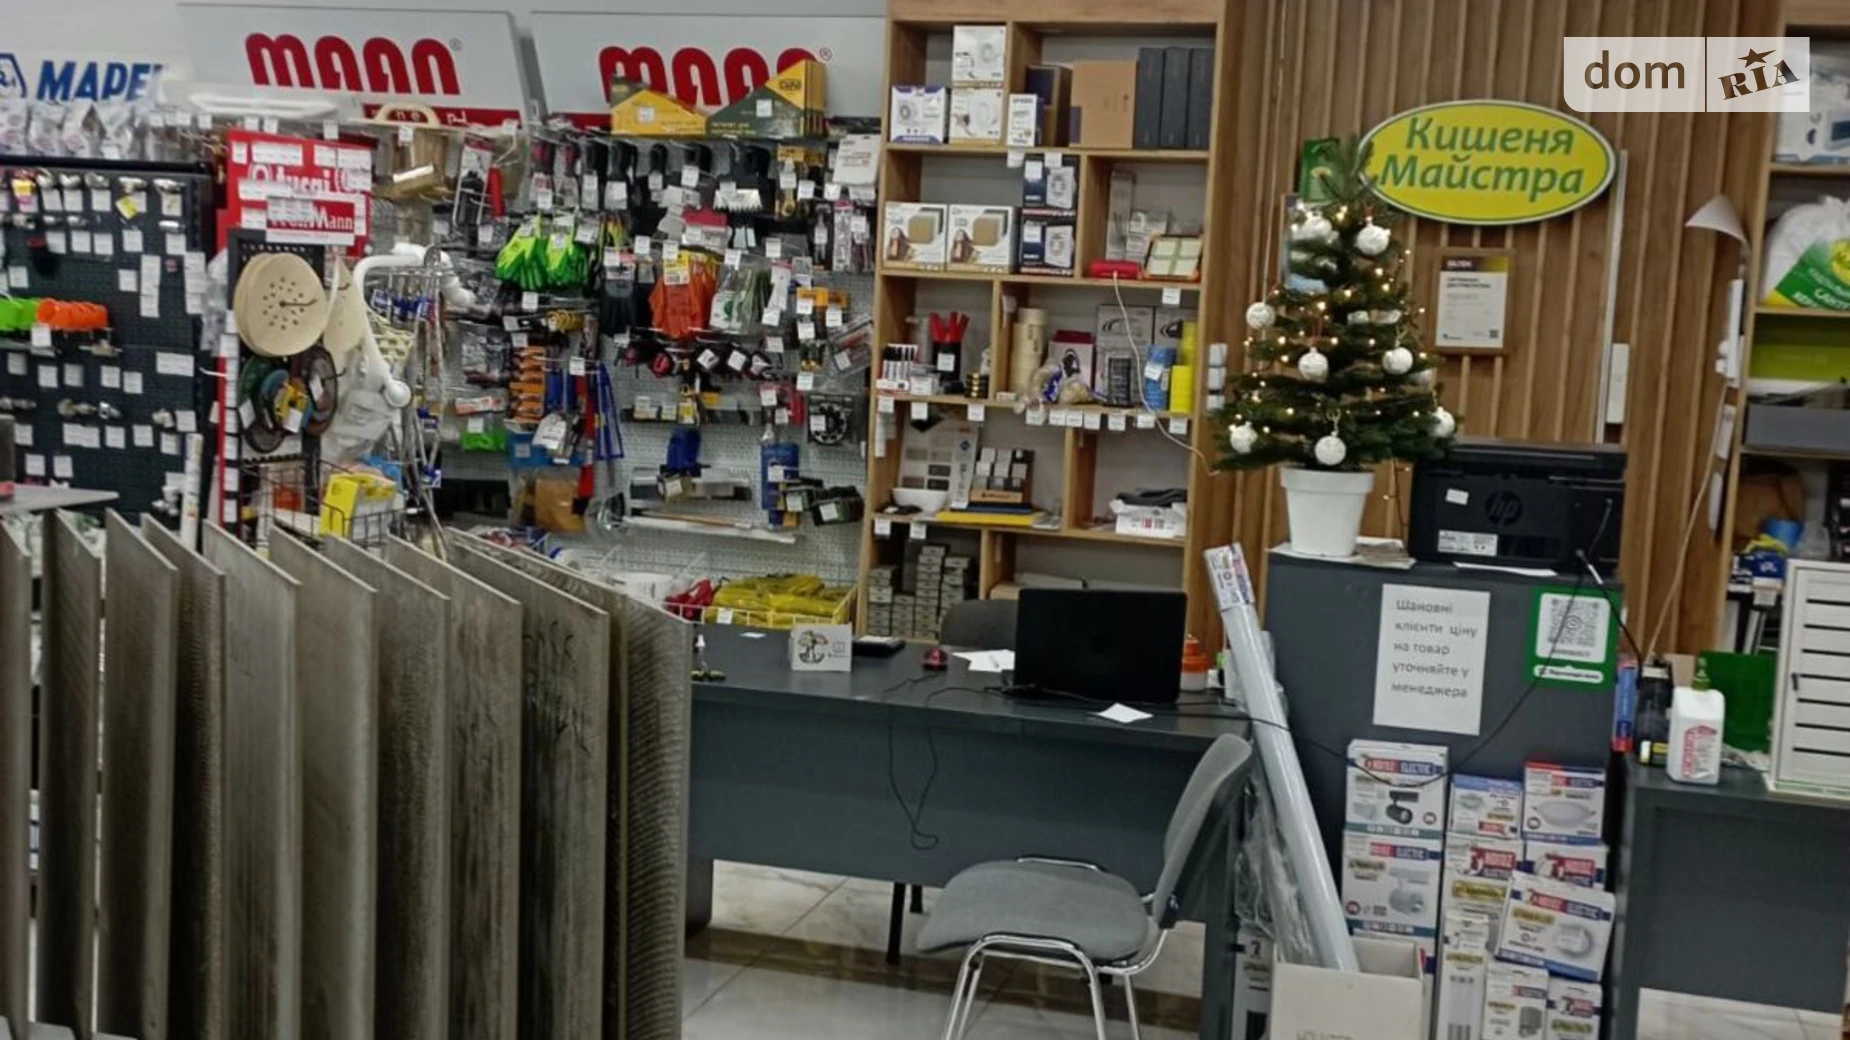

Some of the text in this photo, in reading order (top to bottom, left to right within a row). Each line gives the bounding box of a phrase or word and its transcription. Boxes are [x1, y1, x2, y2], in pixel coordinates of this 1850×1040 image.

[36, 60, 163, 102] MAPE
[1406, 117, 1575, 155] Кишеня
[1379, 153, 1585, 203] Майстра
[1396, 599, 1453, 614] Шановні
[1449, 624, 1479, 638] ціну
[1393, 642, 1450, 655] на товар
[1392, 662, 1470, 679] уточняйте у
[1391, 683, 1468, 699] менеджера
